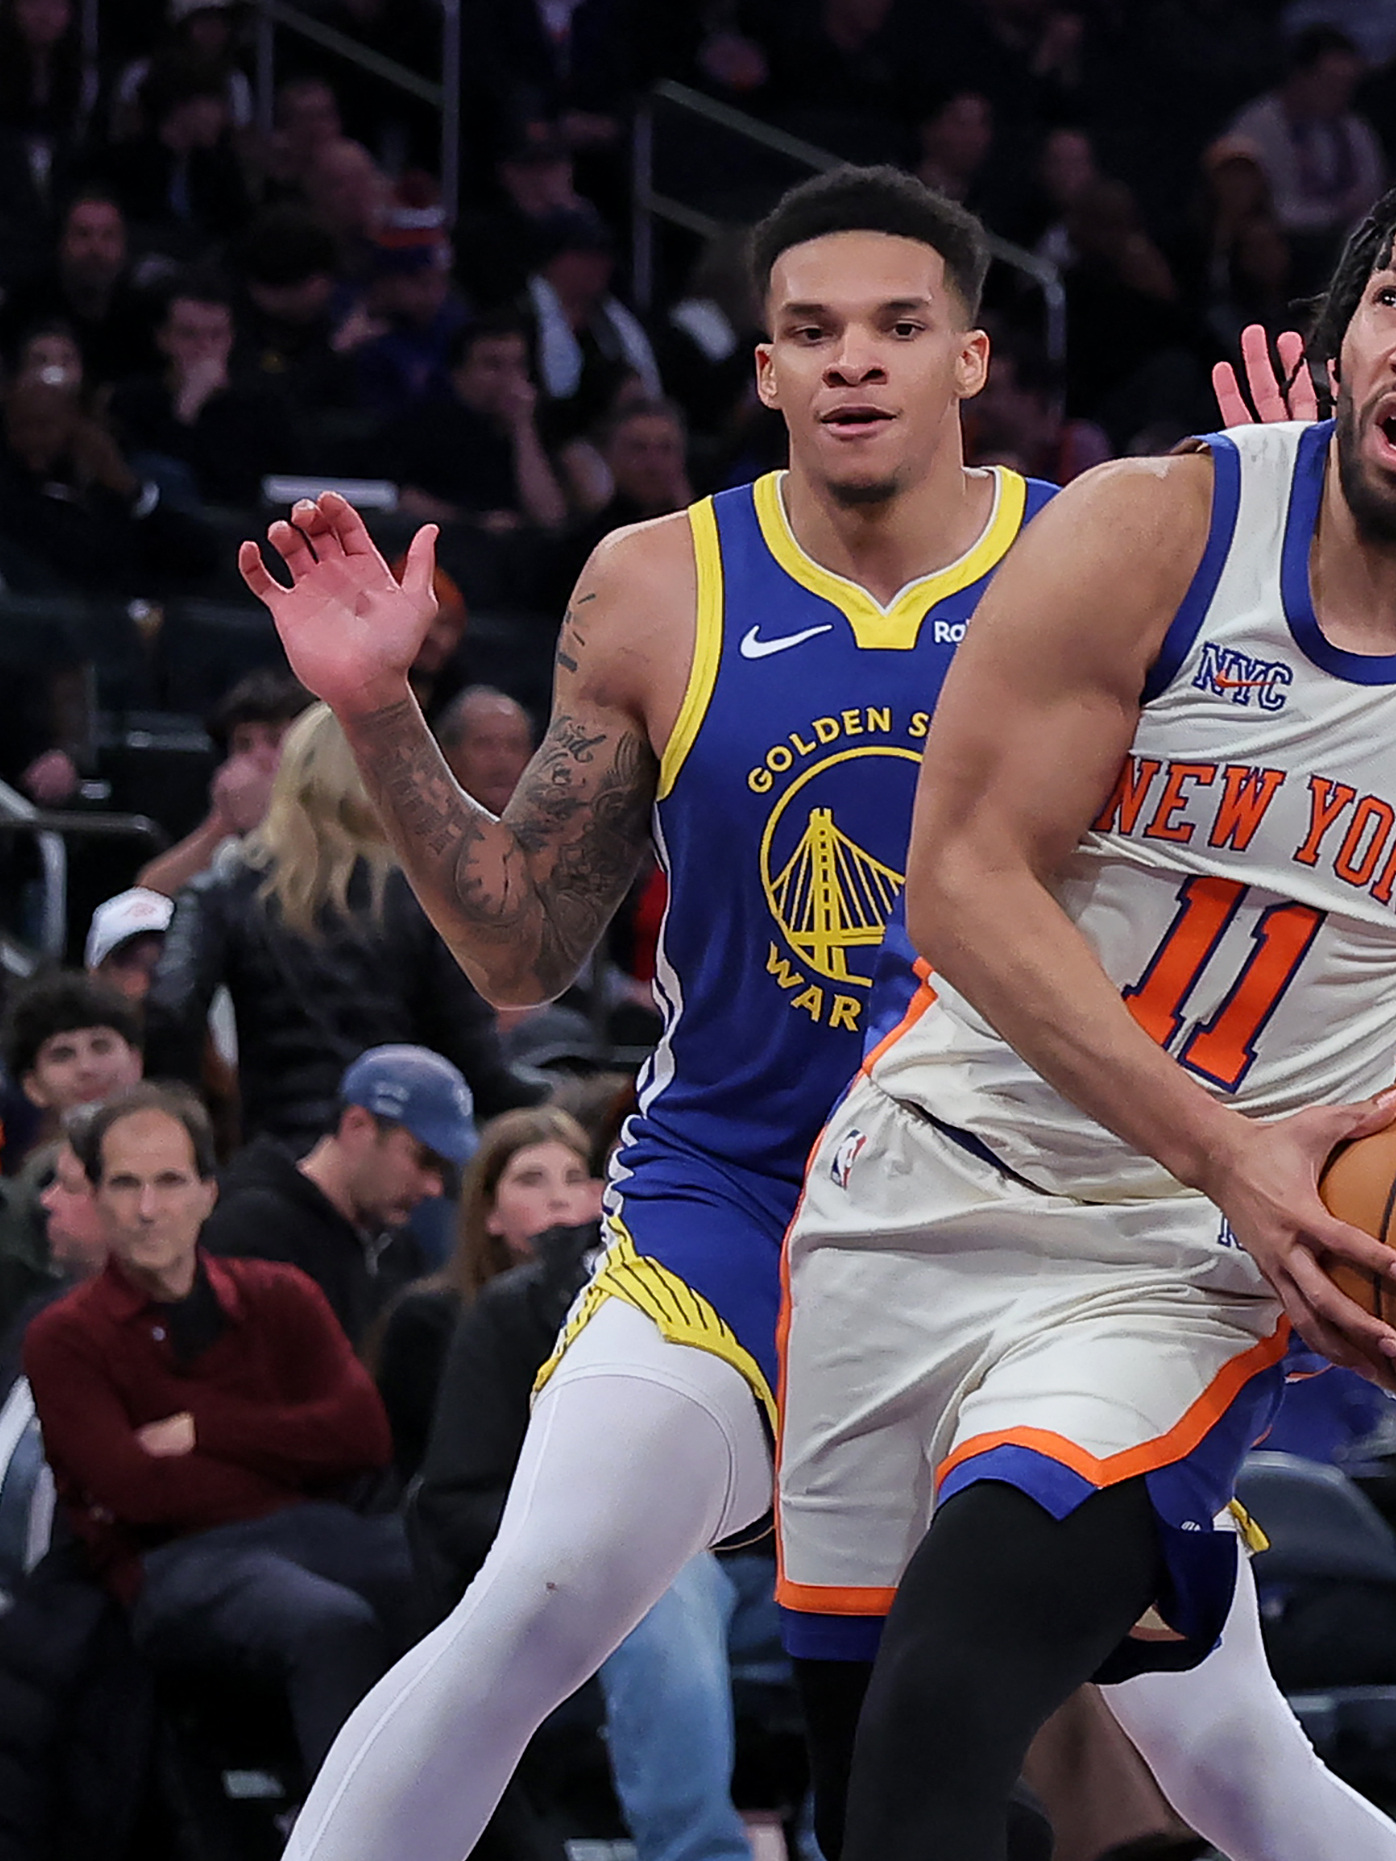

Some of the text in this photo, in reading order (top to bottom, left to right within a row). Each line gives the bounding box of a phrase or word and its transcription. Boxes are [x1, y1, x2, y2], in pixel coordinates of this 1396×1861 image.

[1192, 642, 1293, 711] NYC
[748, 707, 891, 793] GOLDEN
[1090, 752, 1287, 852] NEW
[1121, 873, 1330, 1094] 11
